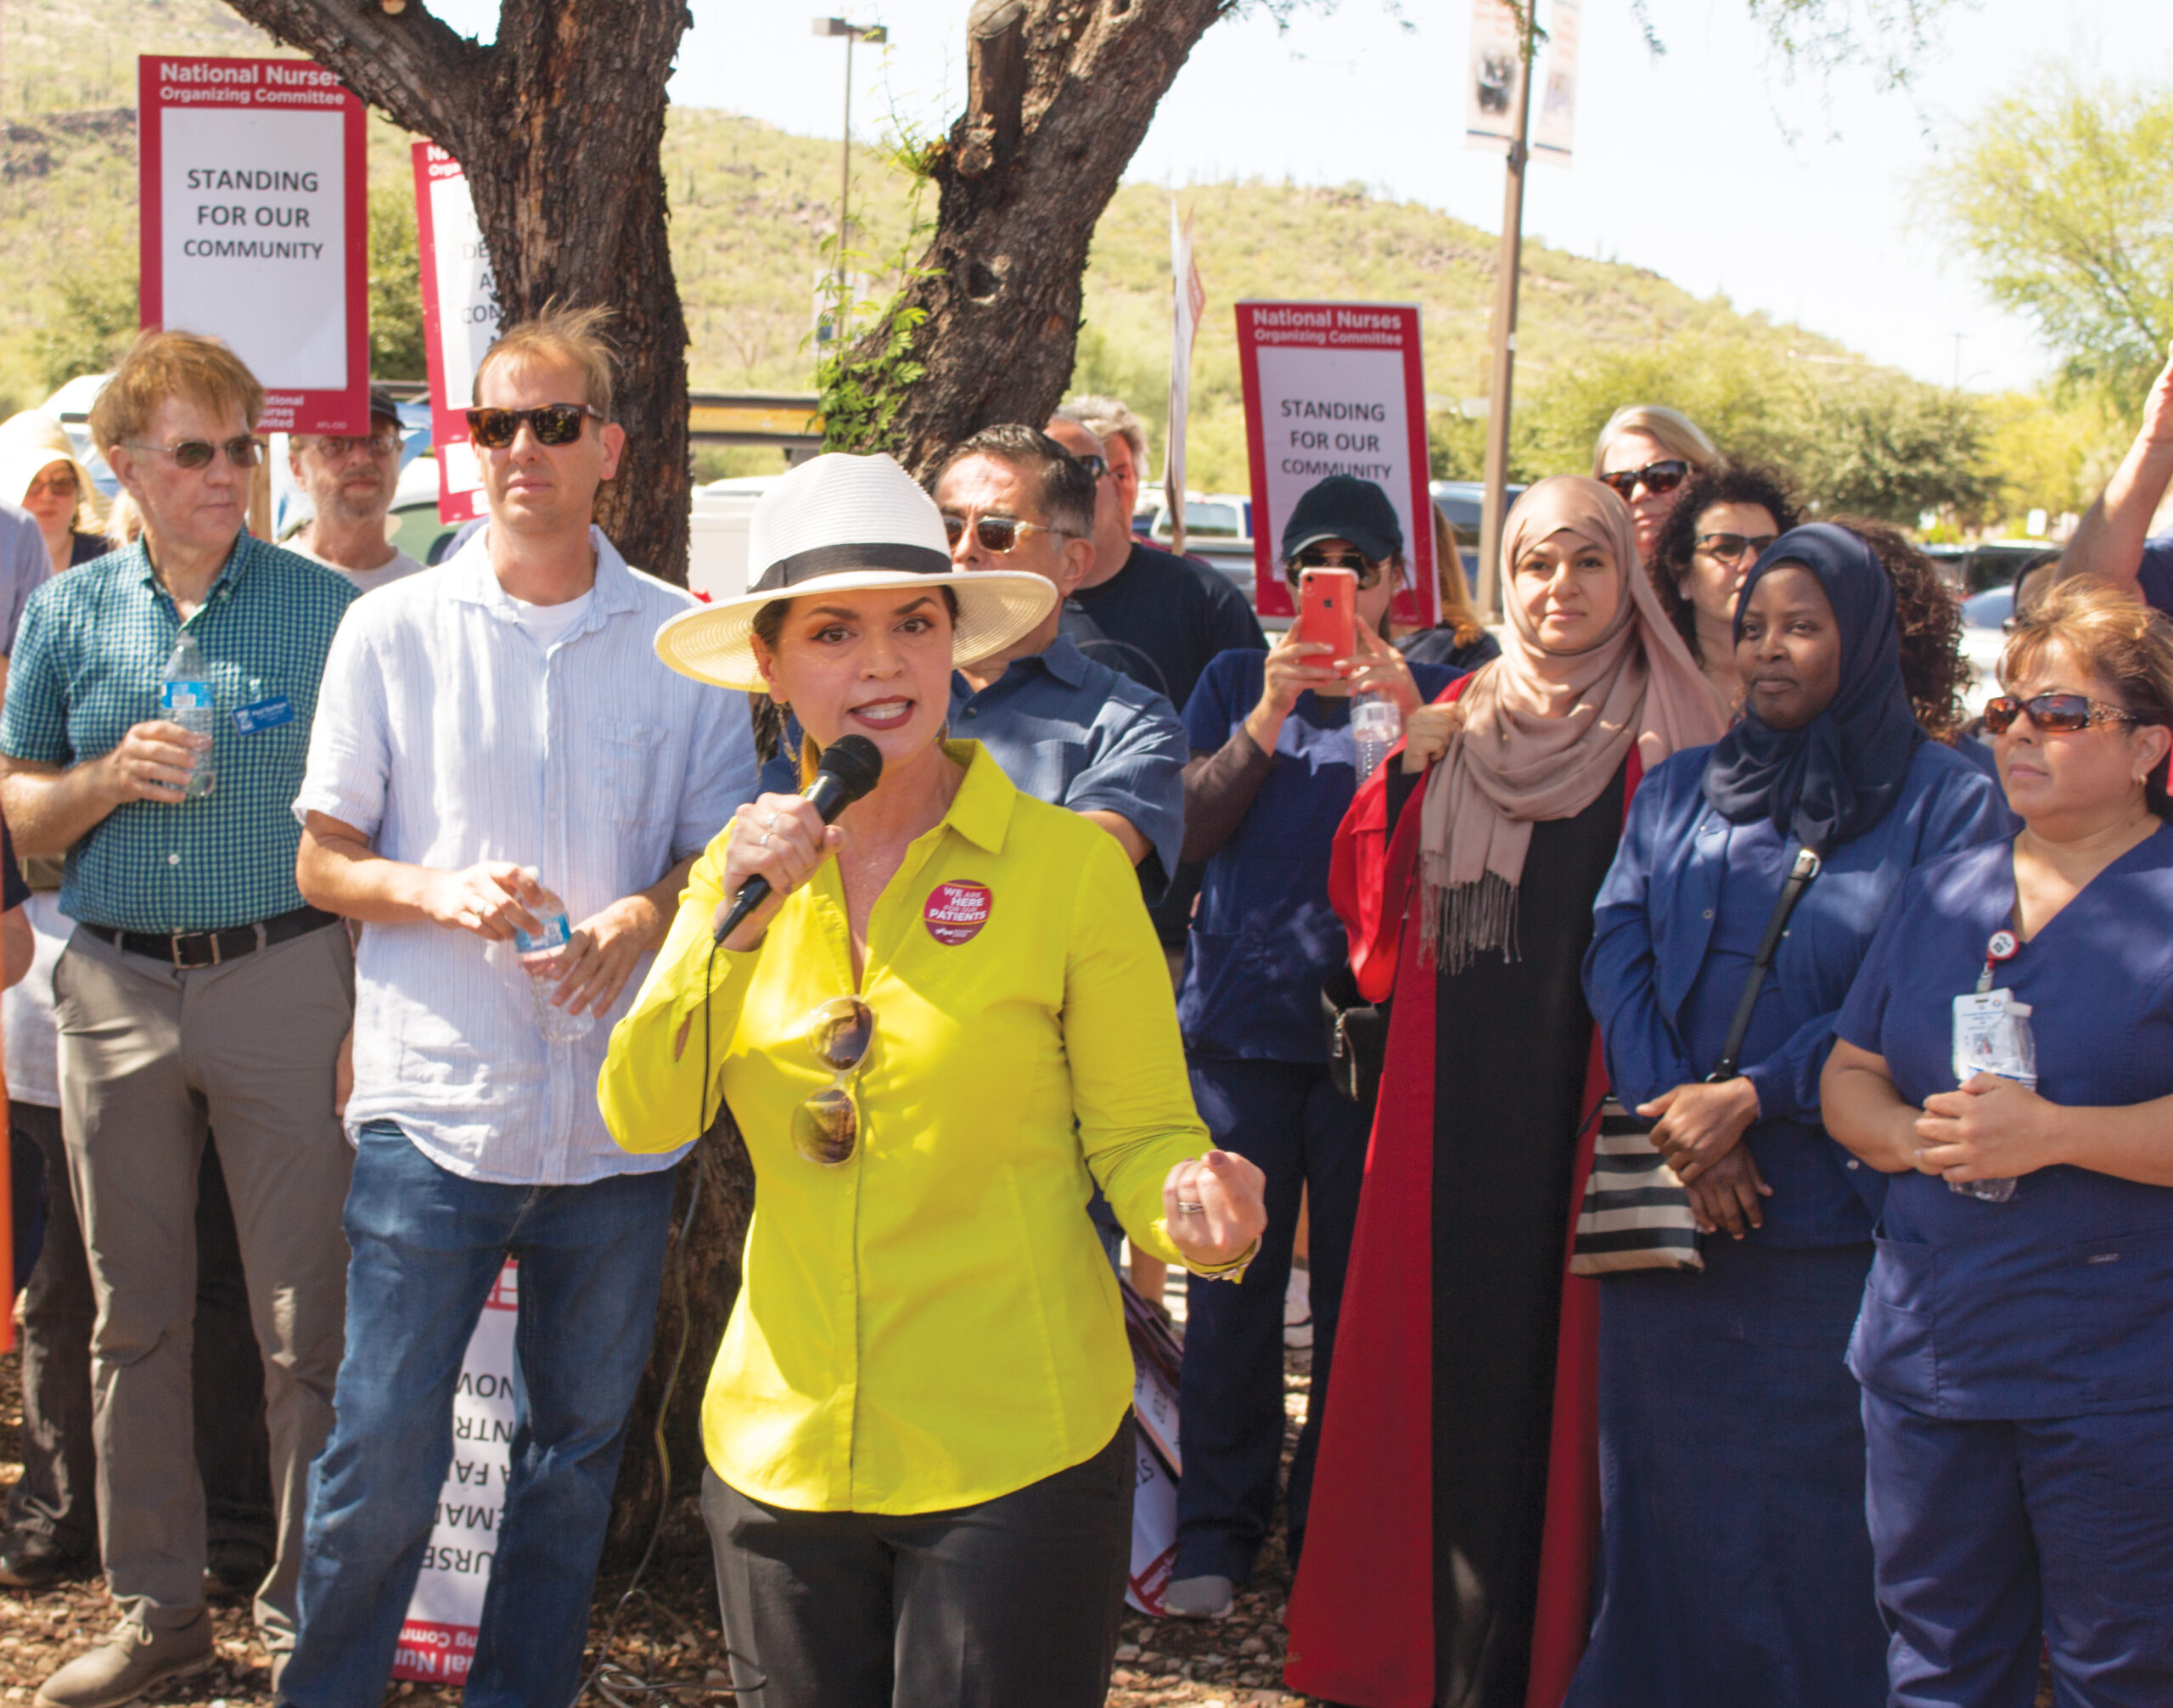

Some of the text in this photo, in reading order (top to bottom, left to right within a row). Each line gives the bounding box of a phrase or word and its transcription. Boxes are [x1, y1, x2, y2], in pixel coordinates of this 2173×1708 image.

[160, 63, 259, 83] National
[160, 86, 345, 105] Organizing Committee
[188, 169, 318, 193] STANDING
[198, 205, 310, 228] FOR OUR
[183, 239, 323, 260] COMMUNITY
[1253, 309, 1401, 329] National Nurses
[1255, 329, 1402, 345] Organizing Committee
[1281, 399, 1385, 422] STANDING
[1290, 430, 1379, 452] FOR OUR
[1282, 458, 1392, 479] COMMUNITY
[944, 887, 964, 897] WE
[951, 897, 985, 907] HERE
[929, 908, 987, 922] PATIENTS
[449, 1460, 489, 1486] FA
